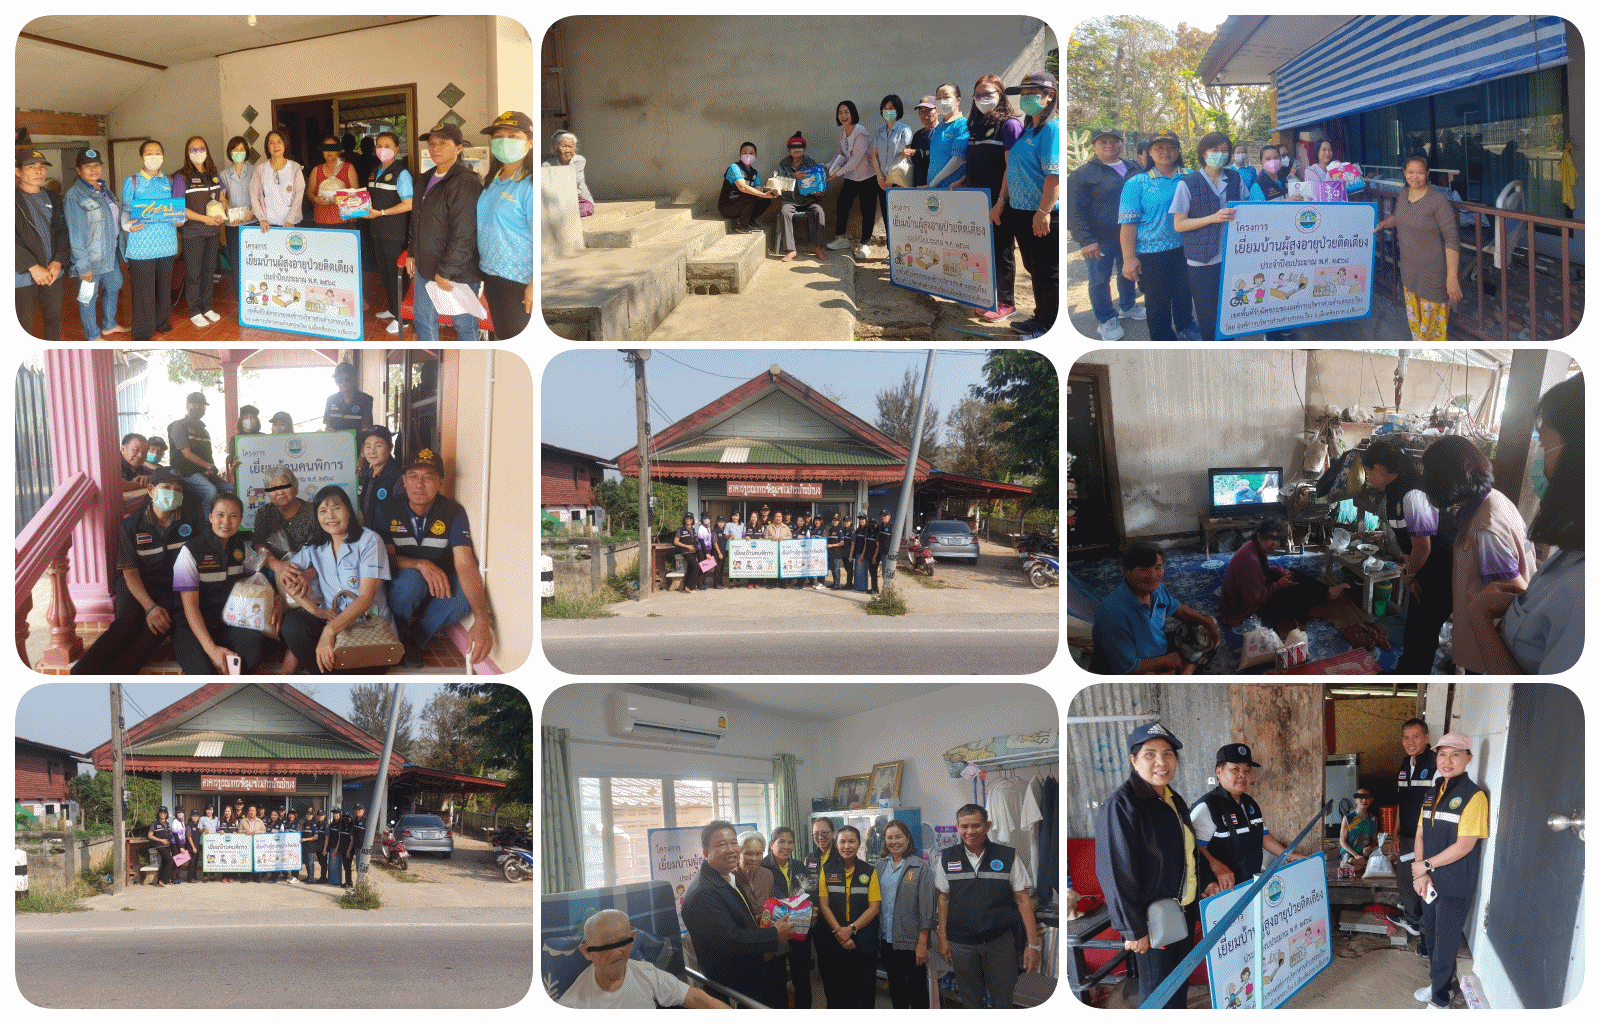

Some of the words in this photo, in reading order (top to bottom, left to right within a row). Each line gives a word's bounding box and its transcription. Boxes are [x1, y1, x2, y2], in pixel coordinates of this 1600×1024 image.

[1236, 221, 1269, 232] โครงการ
[1234, 234, 1369, 256] เยี่ยมบ้านผู้สูงอายุป่วยติดเตียง
[1260, 258, 1317, 270] ประจำปีงบประมาณ
